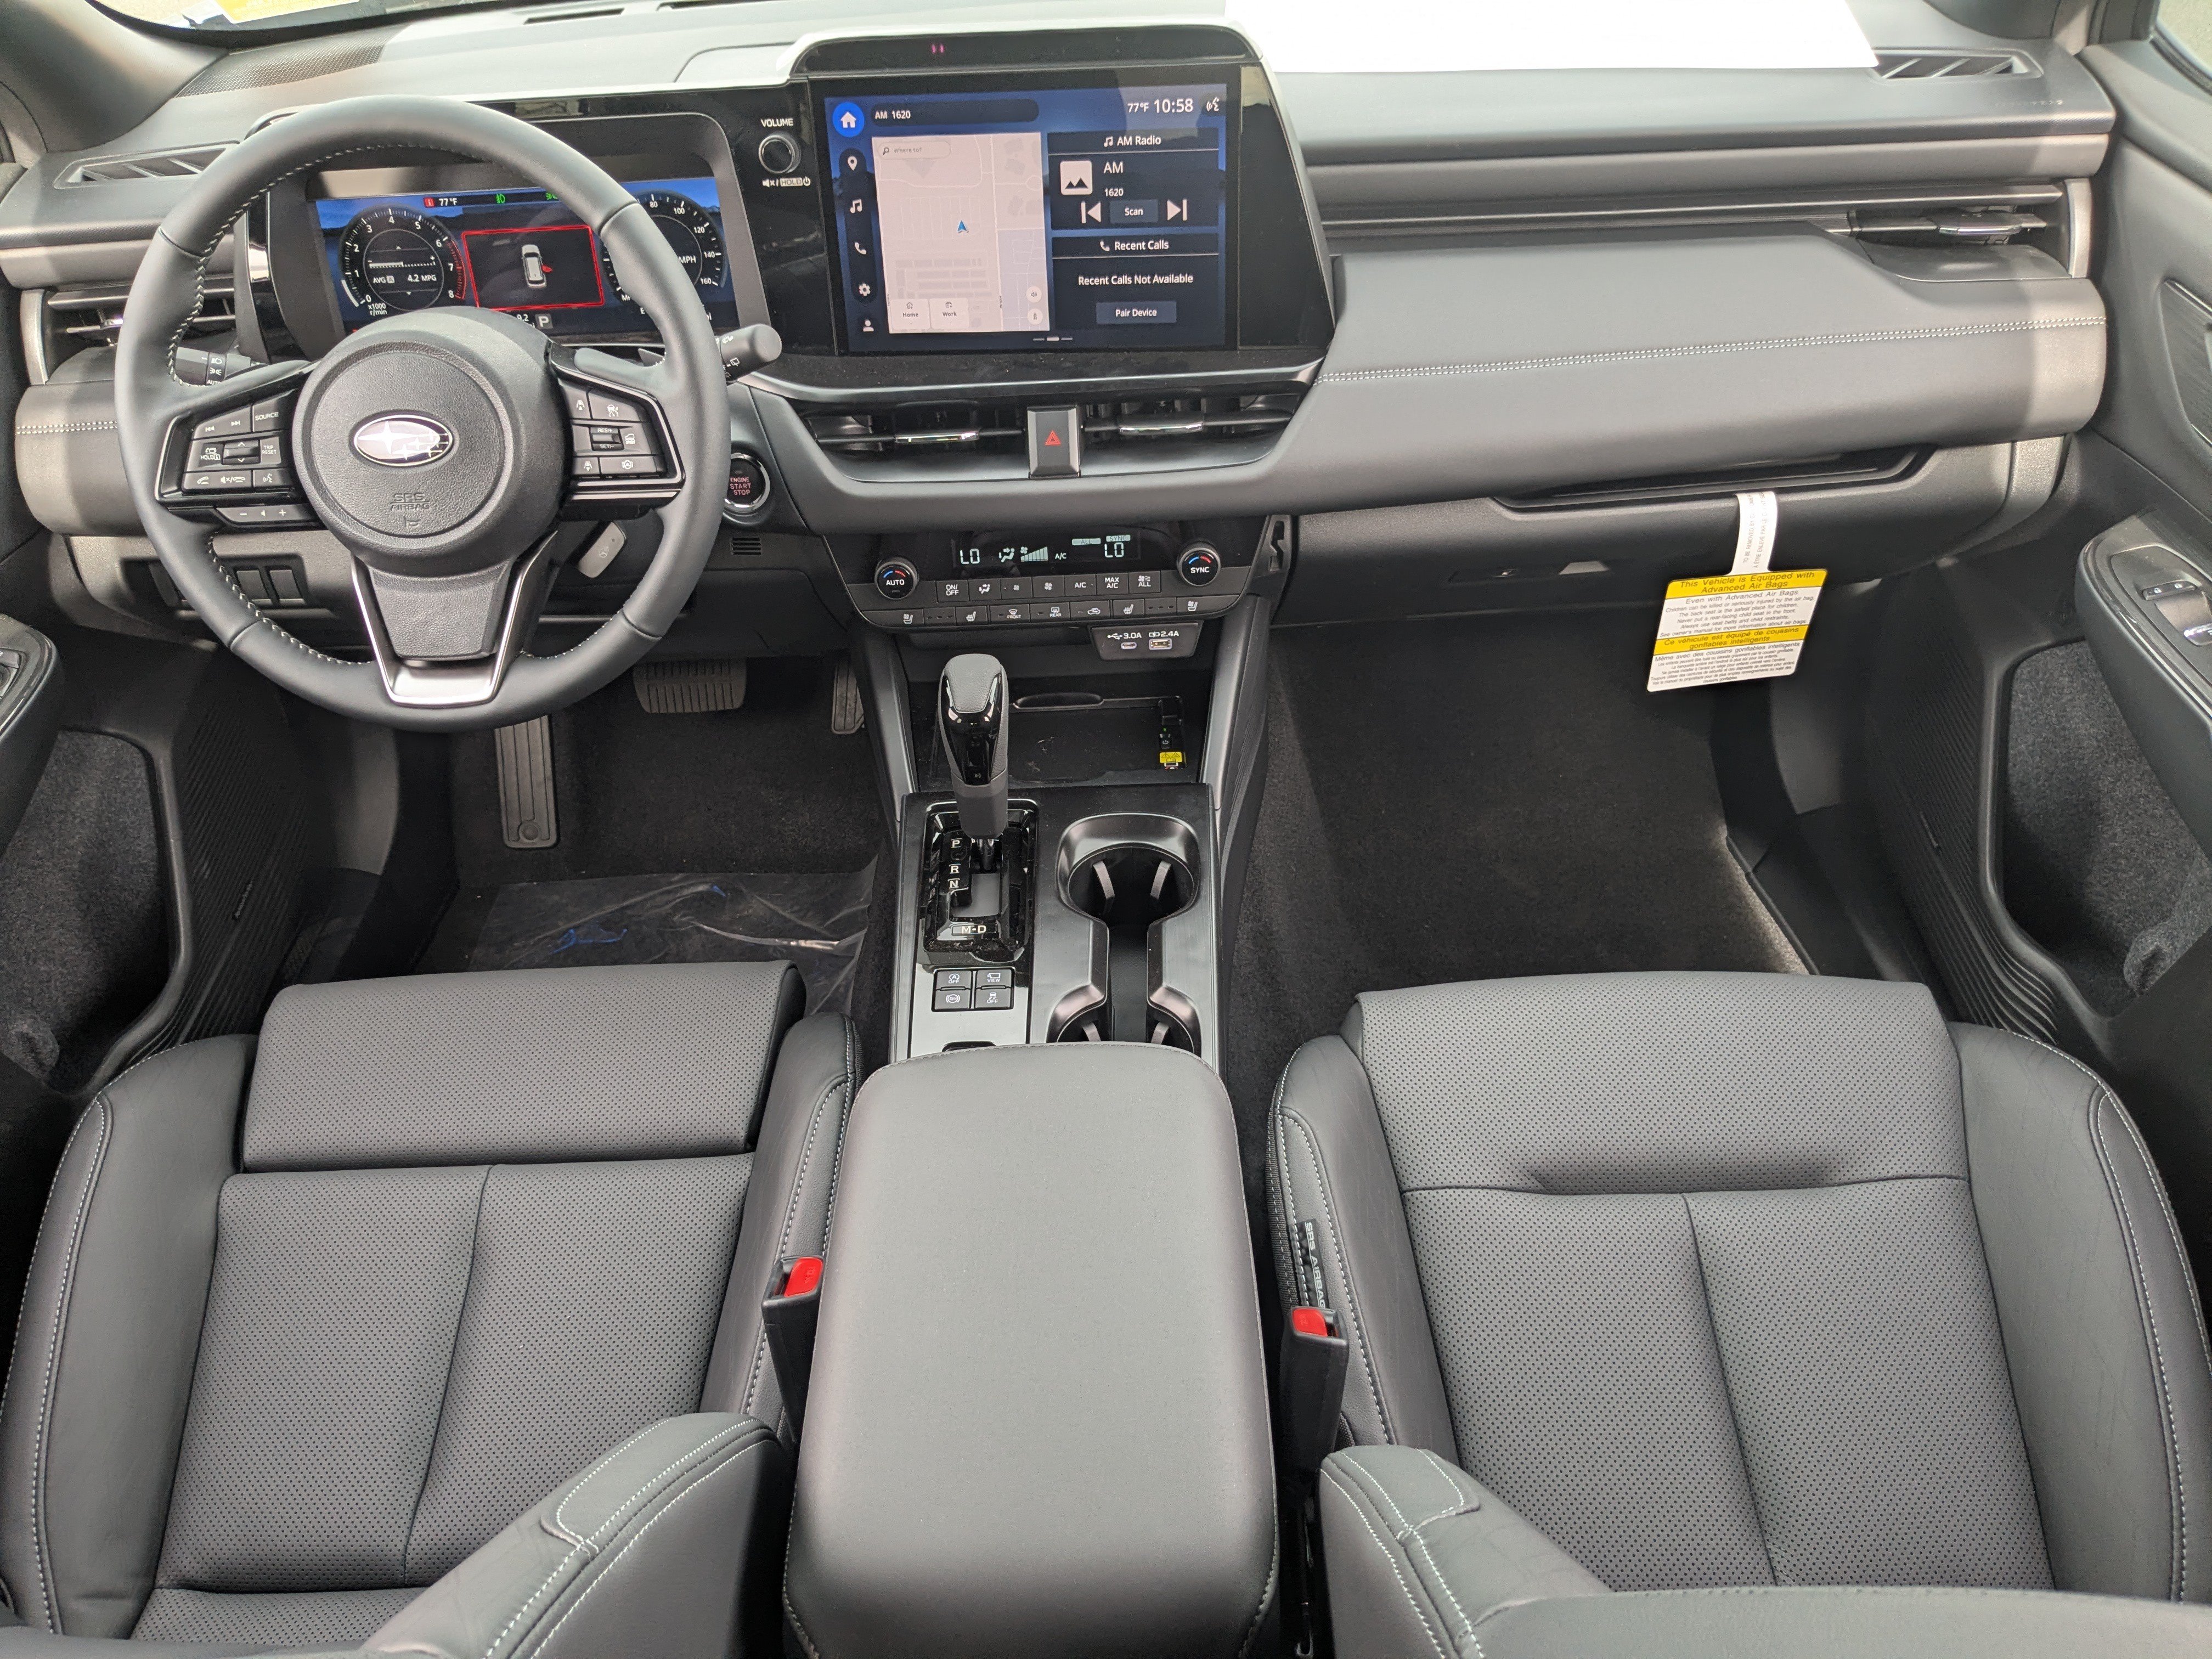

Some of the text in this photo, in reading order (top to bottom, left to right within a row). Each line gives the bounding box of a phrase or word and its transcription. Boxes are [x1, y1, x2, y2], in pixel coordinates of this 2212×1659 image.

[1154, 98, 1193, 113] 10:58
[875, 110, 911, 119] AM 1620
[760, 118, 794, 127] VOLUME
[1117, 136, 1161, 145] AM Radio
[1104, 161, 1123, 173] AM
[1104, 188, 1124, 196] 1620
[1125, 207, 1143, 216] Scan
[436, 239, 442, 247] 6
[1115, 240, 1169, 250] Recent Calls
[353, 244, 359, 252] 2
[448, 263, 454, 272] 7
[408, 274, 419, 283] 4.2
[1078, 273, 1193, 285] Recent Calls Not Available
[449, 290, 454, 298] 8
[1115, 308, 1157, 317] Pair Device
[538, 315, 549, 328] P
[255, 412, 279, 421] SOURCE
[393, 493, 426, 502] SRS
[391, 504, 430, 512] AIRBAG
[1703, 578, 1735, 586] Vehicle
[1750, 573, 1793, 582] Equipped
[1701, 584, 1745, 594] Advanced
[1306, 1222, 1326, 1309] SRS AIRBAG
